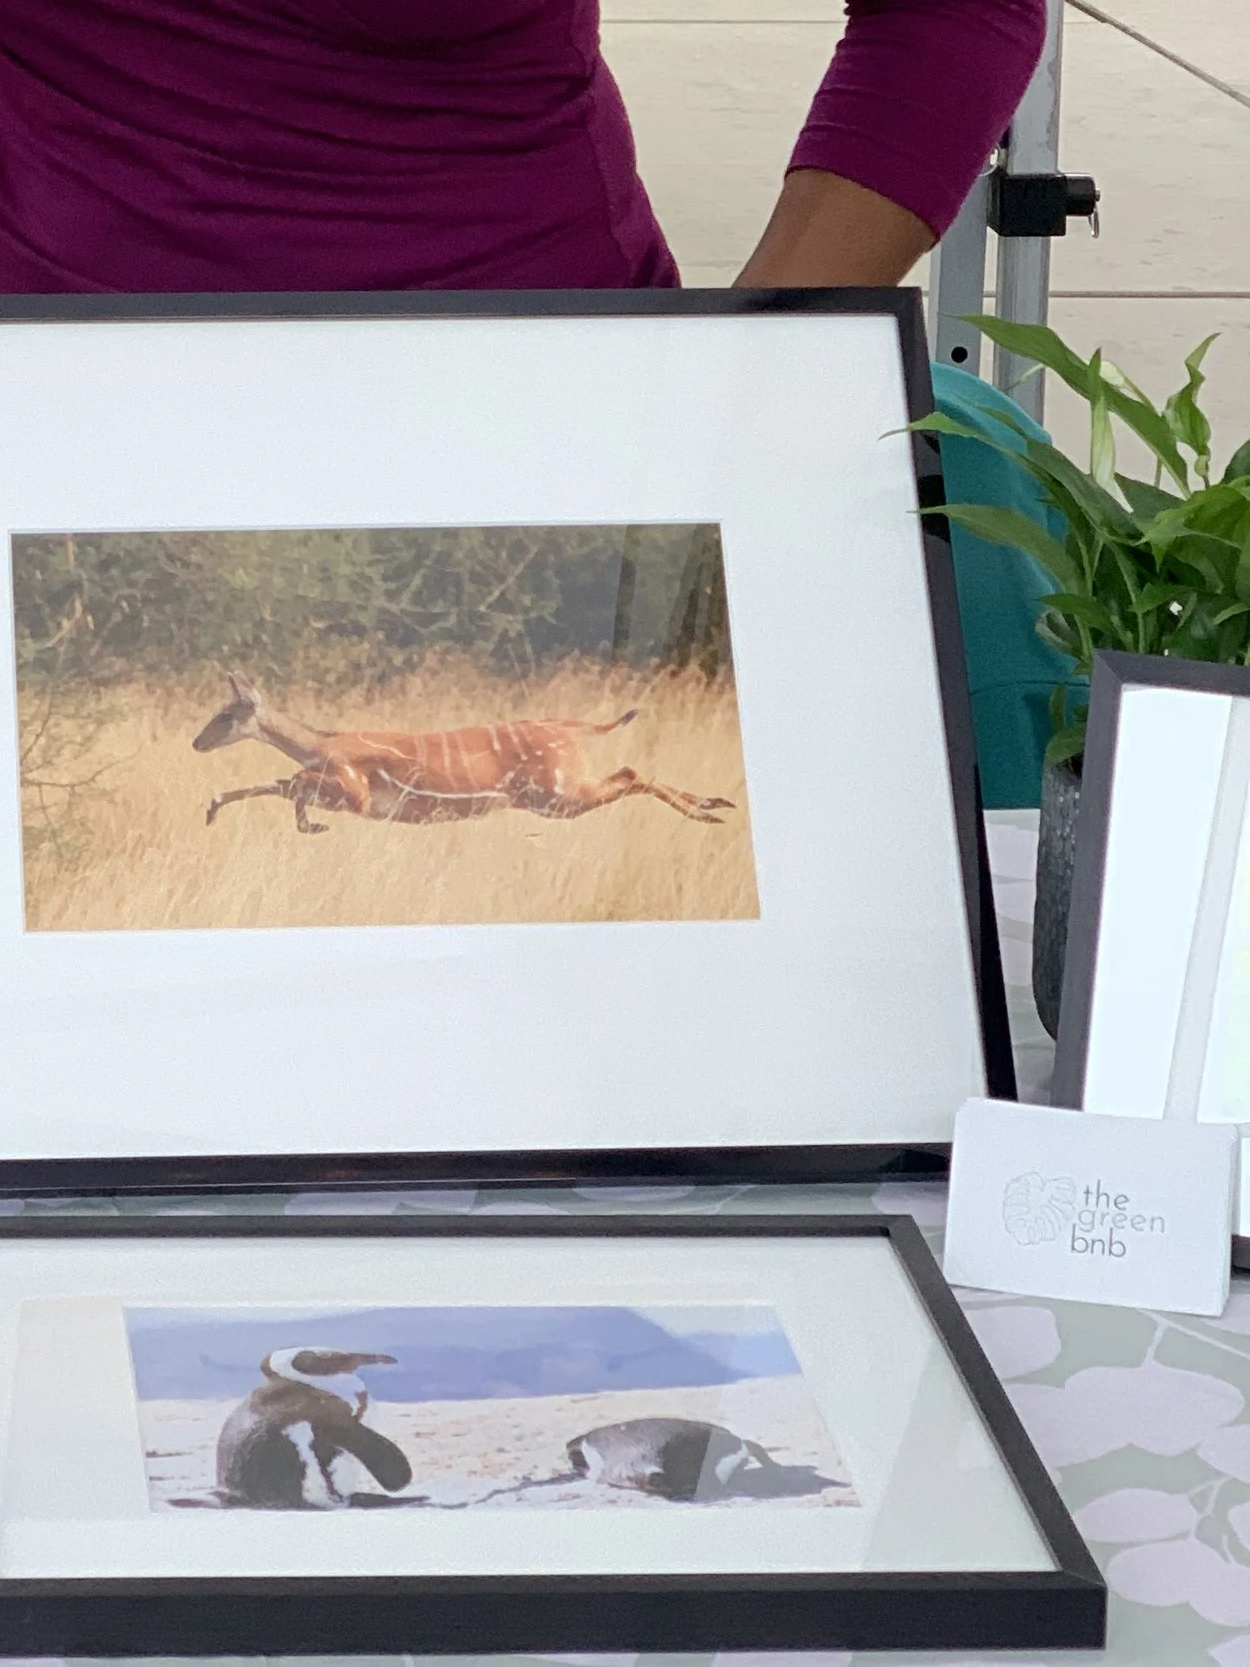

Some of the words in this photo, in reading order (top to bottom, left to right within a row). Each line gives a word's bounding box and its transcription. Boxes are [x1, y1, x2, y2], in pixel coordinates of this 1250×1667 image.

[1083, 1178, 1129, 1211] the
[1078, 1209, 1165, 1233] green
[1071, 1223, 1126, 1258] bnb
